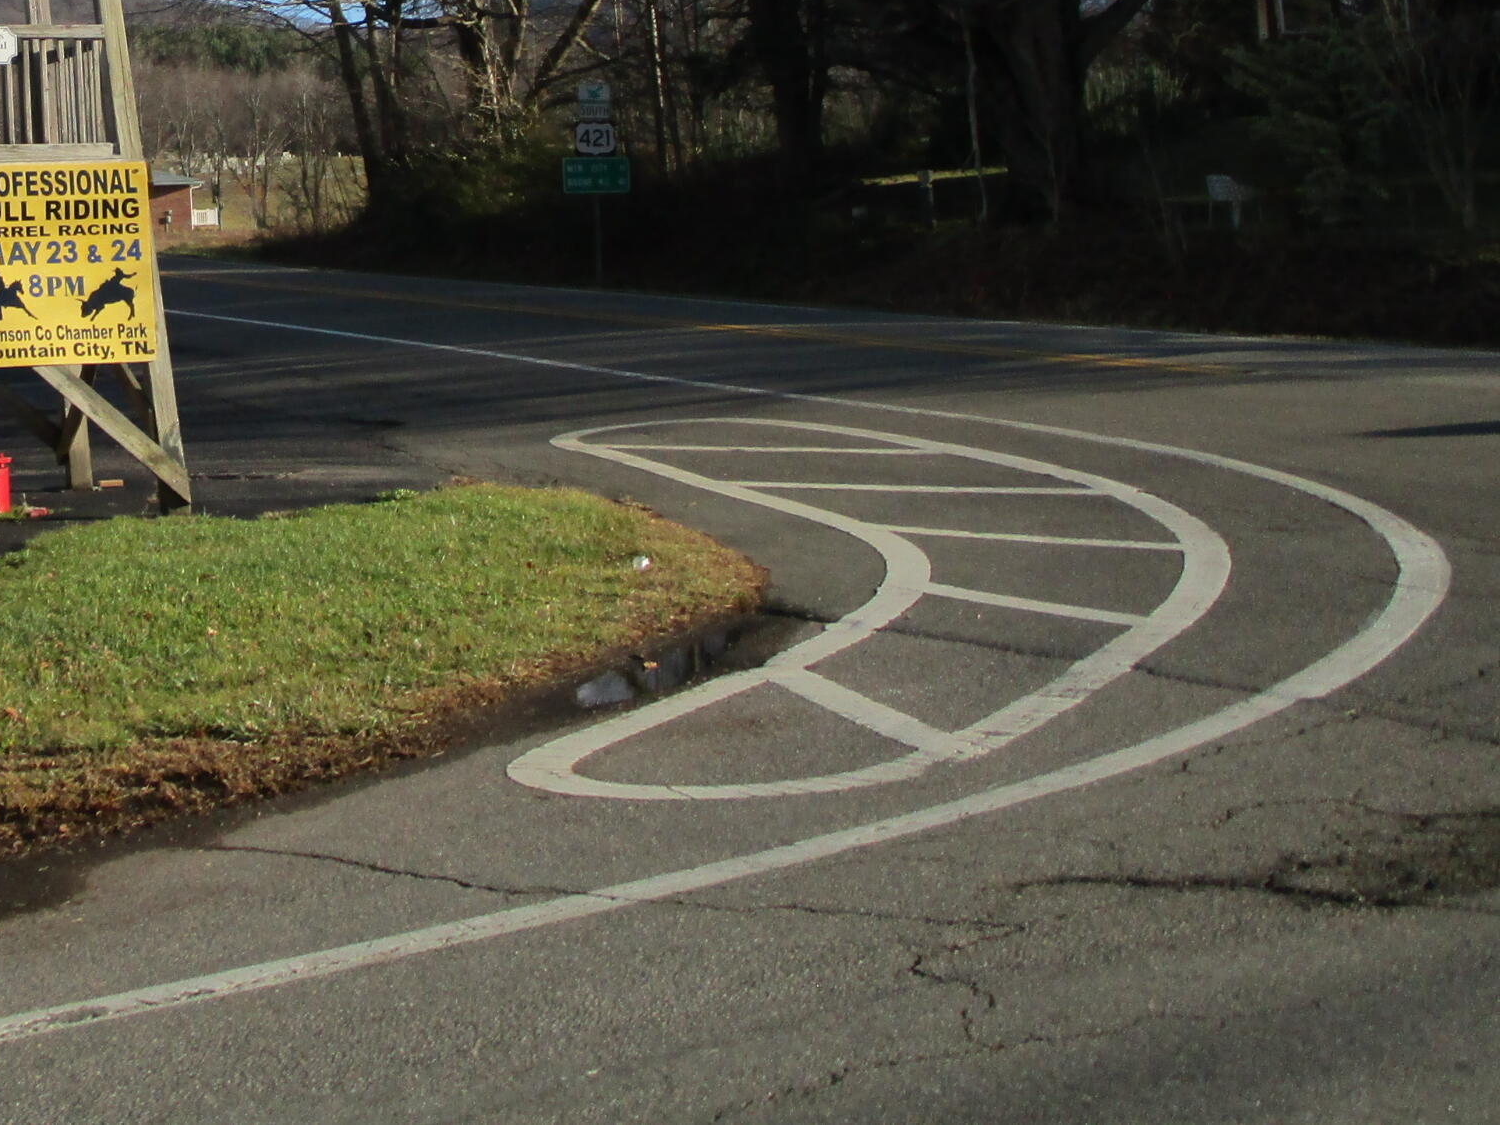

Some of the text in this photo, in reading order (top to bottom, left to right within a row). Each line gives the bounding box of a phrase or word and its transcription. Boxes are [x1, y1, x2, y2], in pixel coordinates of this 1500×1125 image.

[579, 129, 611, 148] 421
[45, 197, 141, 221] RIDING
[58, 222, 141, 237] RACING
[46, 240, 78, 265] 23
[87, 245, 103, 264] &
[110, 239, 143, 262] 24
[28, 274, 86, 299] 8PM
[35, 327, 52, 342] Co
[55, 324, 114, 341] Chamber
[117, 323, 148, 339] Park
[73, 343, 116, 360] City,
